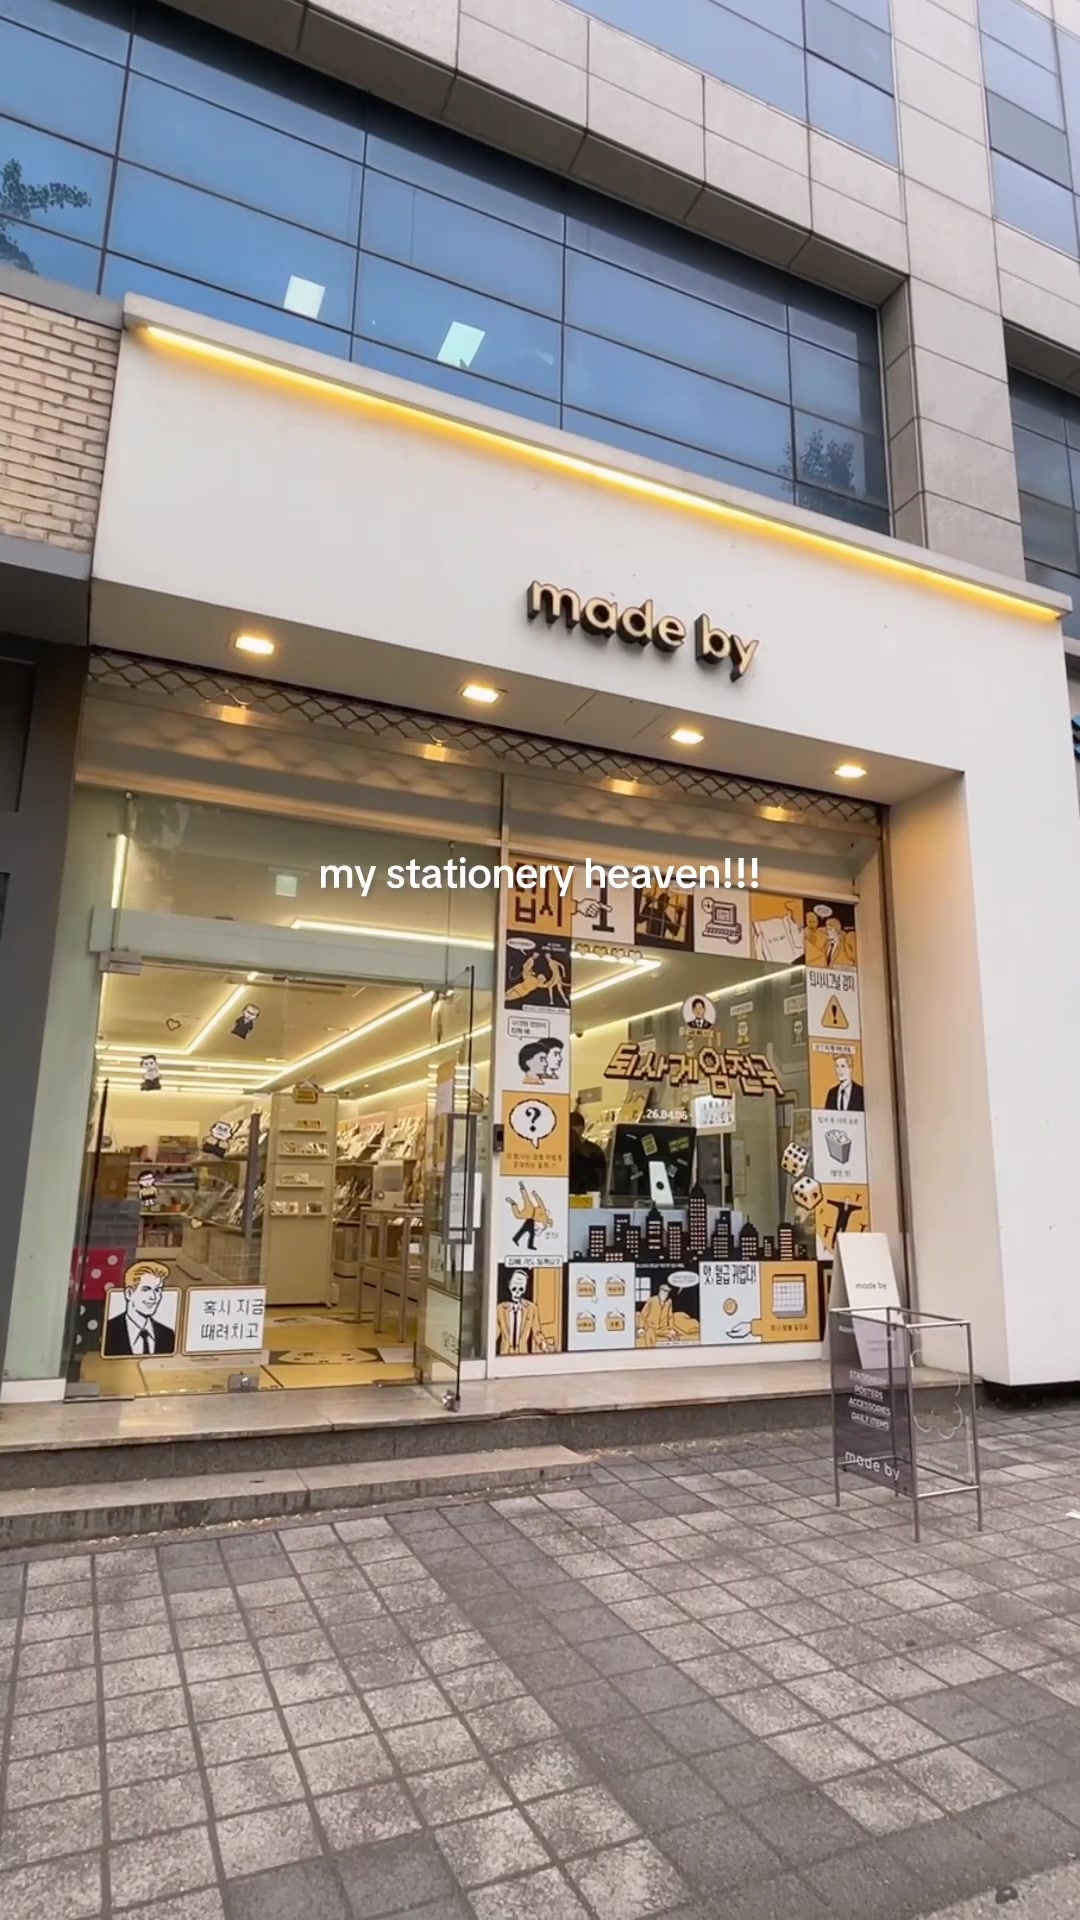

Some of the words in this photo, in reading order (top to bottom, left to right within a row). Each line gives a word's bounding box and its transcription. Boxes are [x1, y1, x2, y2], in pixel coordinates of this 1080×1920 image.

[527, 580, 686, 653] made
[695, 613, 759, 682] by
[855, 1281, 877, 1290] made
[878, 1281, 887, 1291] by
[203, 1299, 231, 1316] 혹시
[236, 1298, 265, 1316] 지금
[200, 1322, 259, 1341] 때려치고
[845, 1451, 880, 1472] made
[884, 1462, 900, 1481] by
